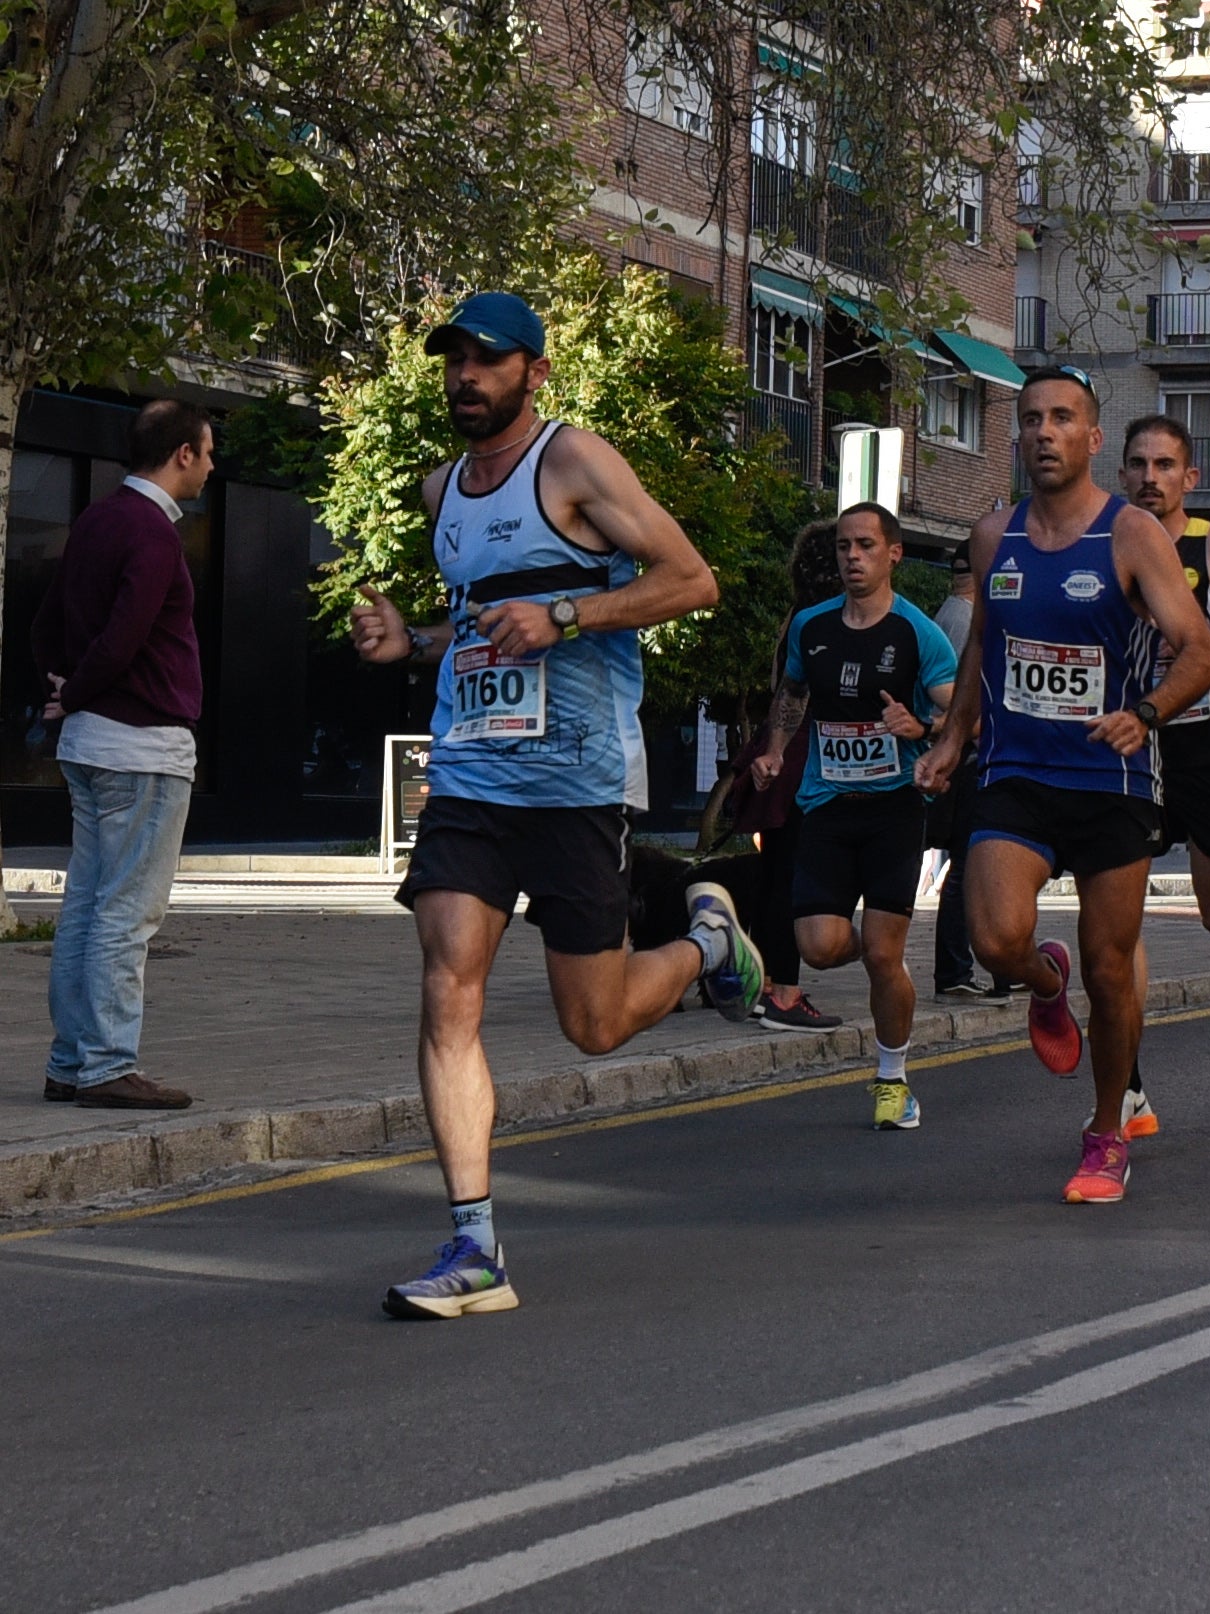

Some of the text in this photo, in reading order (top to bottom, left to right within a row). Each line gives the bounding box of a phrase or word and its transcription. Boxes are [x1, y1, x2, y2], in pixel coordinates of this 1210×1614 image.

[457, 669, 525, 712] 1760
[1011, 661, 1088, 696] 1065
[823, 738, 886, 762] 4002
